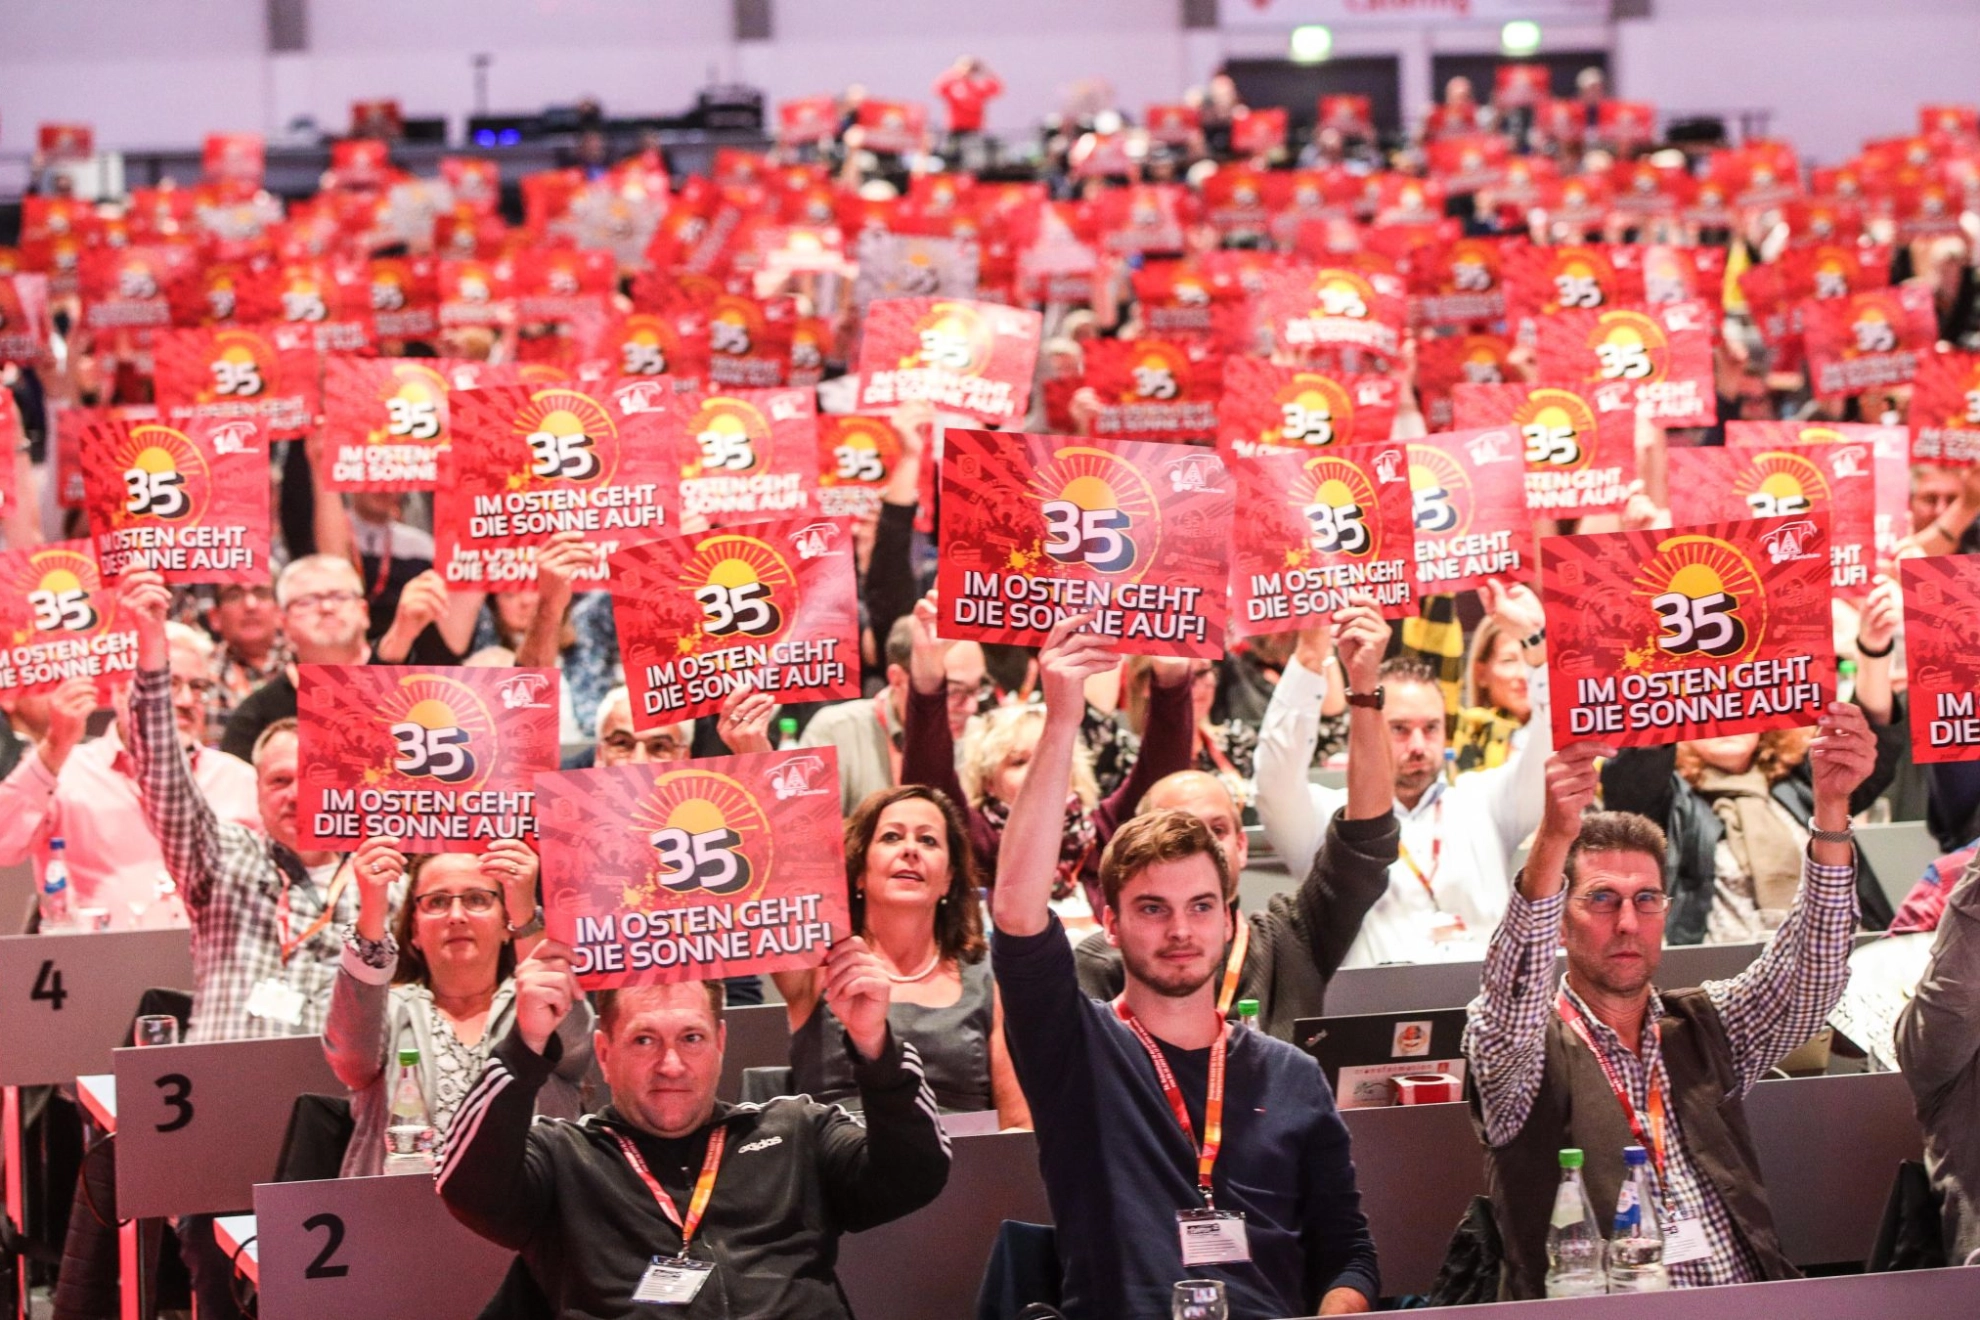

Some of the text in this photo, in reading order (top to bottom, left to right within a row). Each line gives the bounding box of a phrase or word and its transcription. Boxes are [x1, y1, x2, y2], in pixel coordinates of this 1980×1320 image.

[1554, 275, 1602, 308] 35
[712, 320, 751, 355] 35
[921, 330, 970, 367] 35
[1853, 320, 1895, 352] 35
[622, 341, 665, 375] 35
[1596, 343, 1652, 379] 35
[210, 360, 262, 397] 35
[1133, 366, 1178, 400] 35
[386, 398, 440, 440] 35
[1281, 402, 1333, 445] 35
[338, 446, 363, 464] IM
[526, 432, 596, 479] 35
[697, 431, 753, 469] 35
[1522, 424, 1580, 465] 35
[332, 462, 364, 482] DIE
[834, 446, 886, 482] 35
[1571, 467, 1622, 491] GEHT
[124, 468, 188, 516] 35
[474, 484, 658, 516] IM OSTEN GEHT
[1412, 487, 1455, 531] 5
[112, 527, 175, 551] OSTEN
[178, 526, 247, 548] GEHT
[469, 505, 665, 538] DIE SONNE AUF!
[1042, 501, 1131, 568] 35
[1303, 503, 1368, 554] 35
[191, 548, 253, 570] AUF!
[1448, 530, 1513, 557] GEHT
[446, 562, 482, 581] DIE
[486, 562, 538, 581] SON
[1250, 559, 1406, 597] IM OSTEN GEHT
[1463, 551, 1521, 579] AUF!
[1831, 563, 1868, 587] UF!
[696, 583, 778, 634] 35
[963, 570, 1202, 612] IM OSTEN GEHT
[1246, 595, 1291, 621] DIE
[1375, 582, 1411, 606] AUF!
[28, 589, 95, 631] 35
[954, 597, 1005, 627] DIE
[1126, 613, 1207, 642] AUF!
[1652, 592, 1740, 654] 35
[12, 638, 91, 667] OSTEN
[91, 630, 138, 656] GEH
[645, 638, 839, 689] IM OSTEN GEHT
[20, 655, 102, 686] SONNE
[104, 650, 139, 675] AU
[1577, 655, 1813, 705] IM OSTEN GEHT
[643, 662, 846, 715] DIE SONNE AUF!
[1936, 691, 1974, 718] IM
[1569, 683, 1823, 734] DIE SONNE AUF!
[390, 722, 471, 778] 35
[1929, 718, 1980, 746] DIE
[322, 788, 536, 815] IM OSTEN GEHT
[314, 813, 540, 840] DIE SONNE AUF!
[651, 828, 747, 891] 35
[574, 894, 823, 945] IM OSTEN GEHT
[571, 922, 833, 975] DIE SONNE AUF!
[31, 960, 67, 1010] 4
[155, 1073, 194, 1132] 3
[738, 1135, 784, 1154] adidas
[302, 1213, 349, 1279] 2
